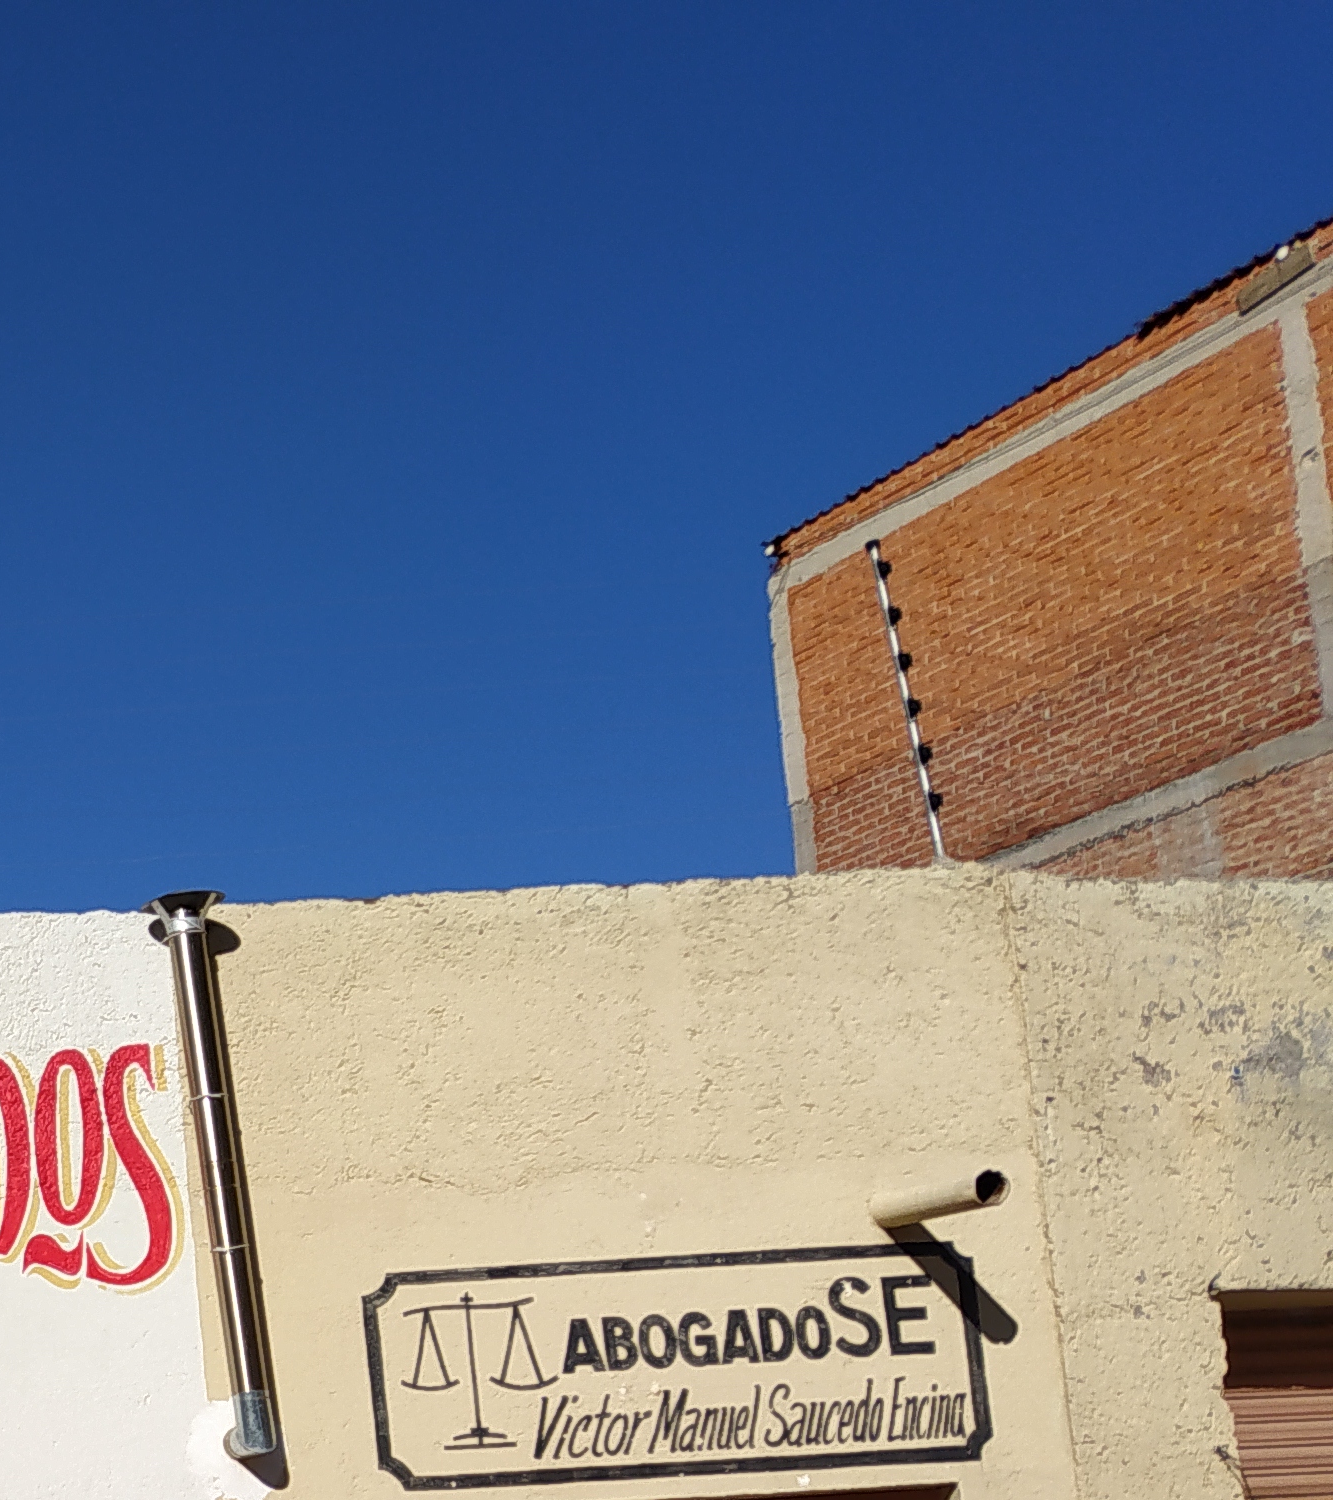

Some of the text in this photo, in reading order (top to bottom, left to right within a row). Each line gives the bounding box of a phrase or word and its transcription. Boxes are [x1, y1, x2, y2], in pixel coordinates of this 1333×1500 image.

[647, 1384, 762, 1457] Manuel
[763, 1377, 885, 1449] Saucedo
[886, 1374, 969, 1443] Encina
